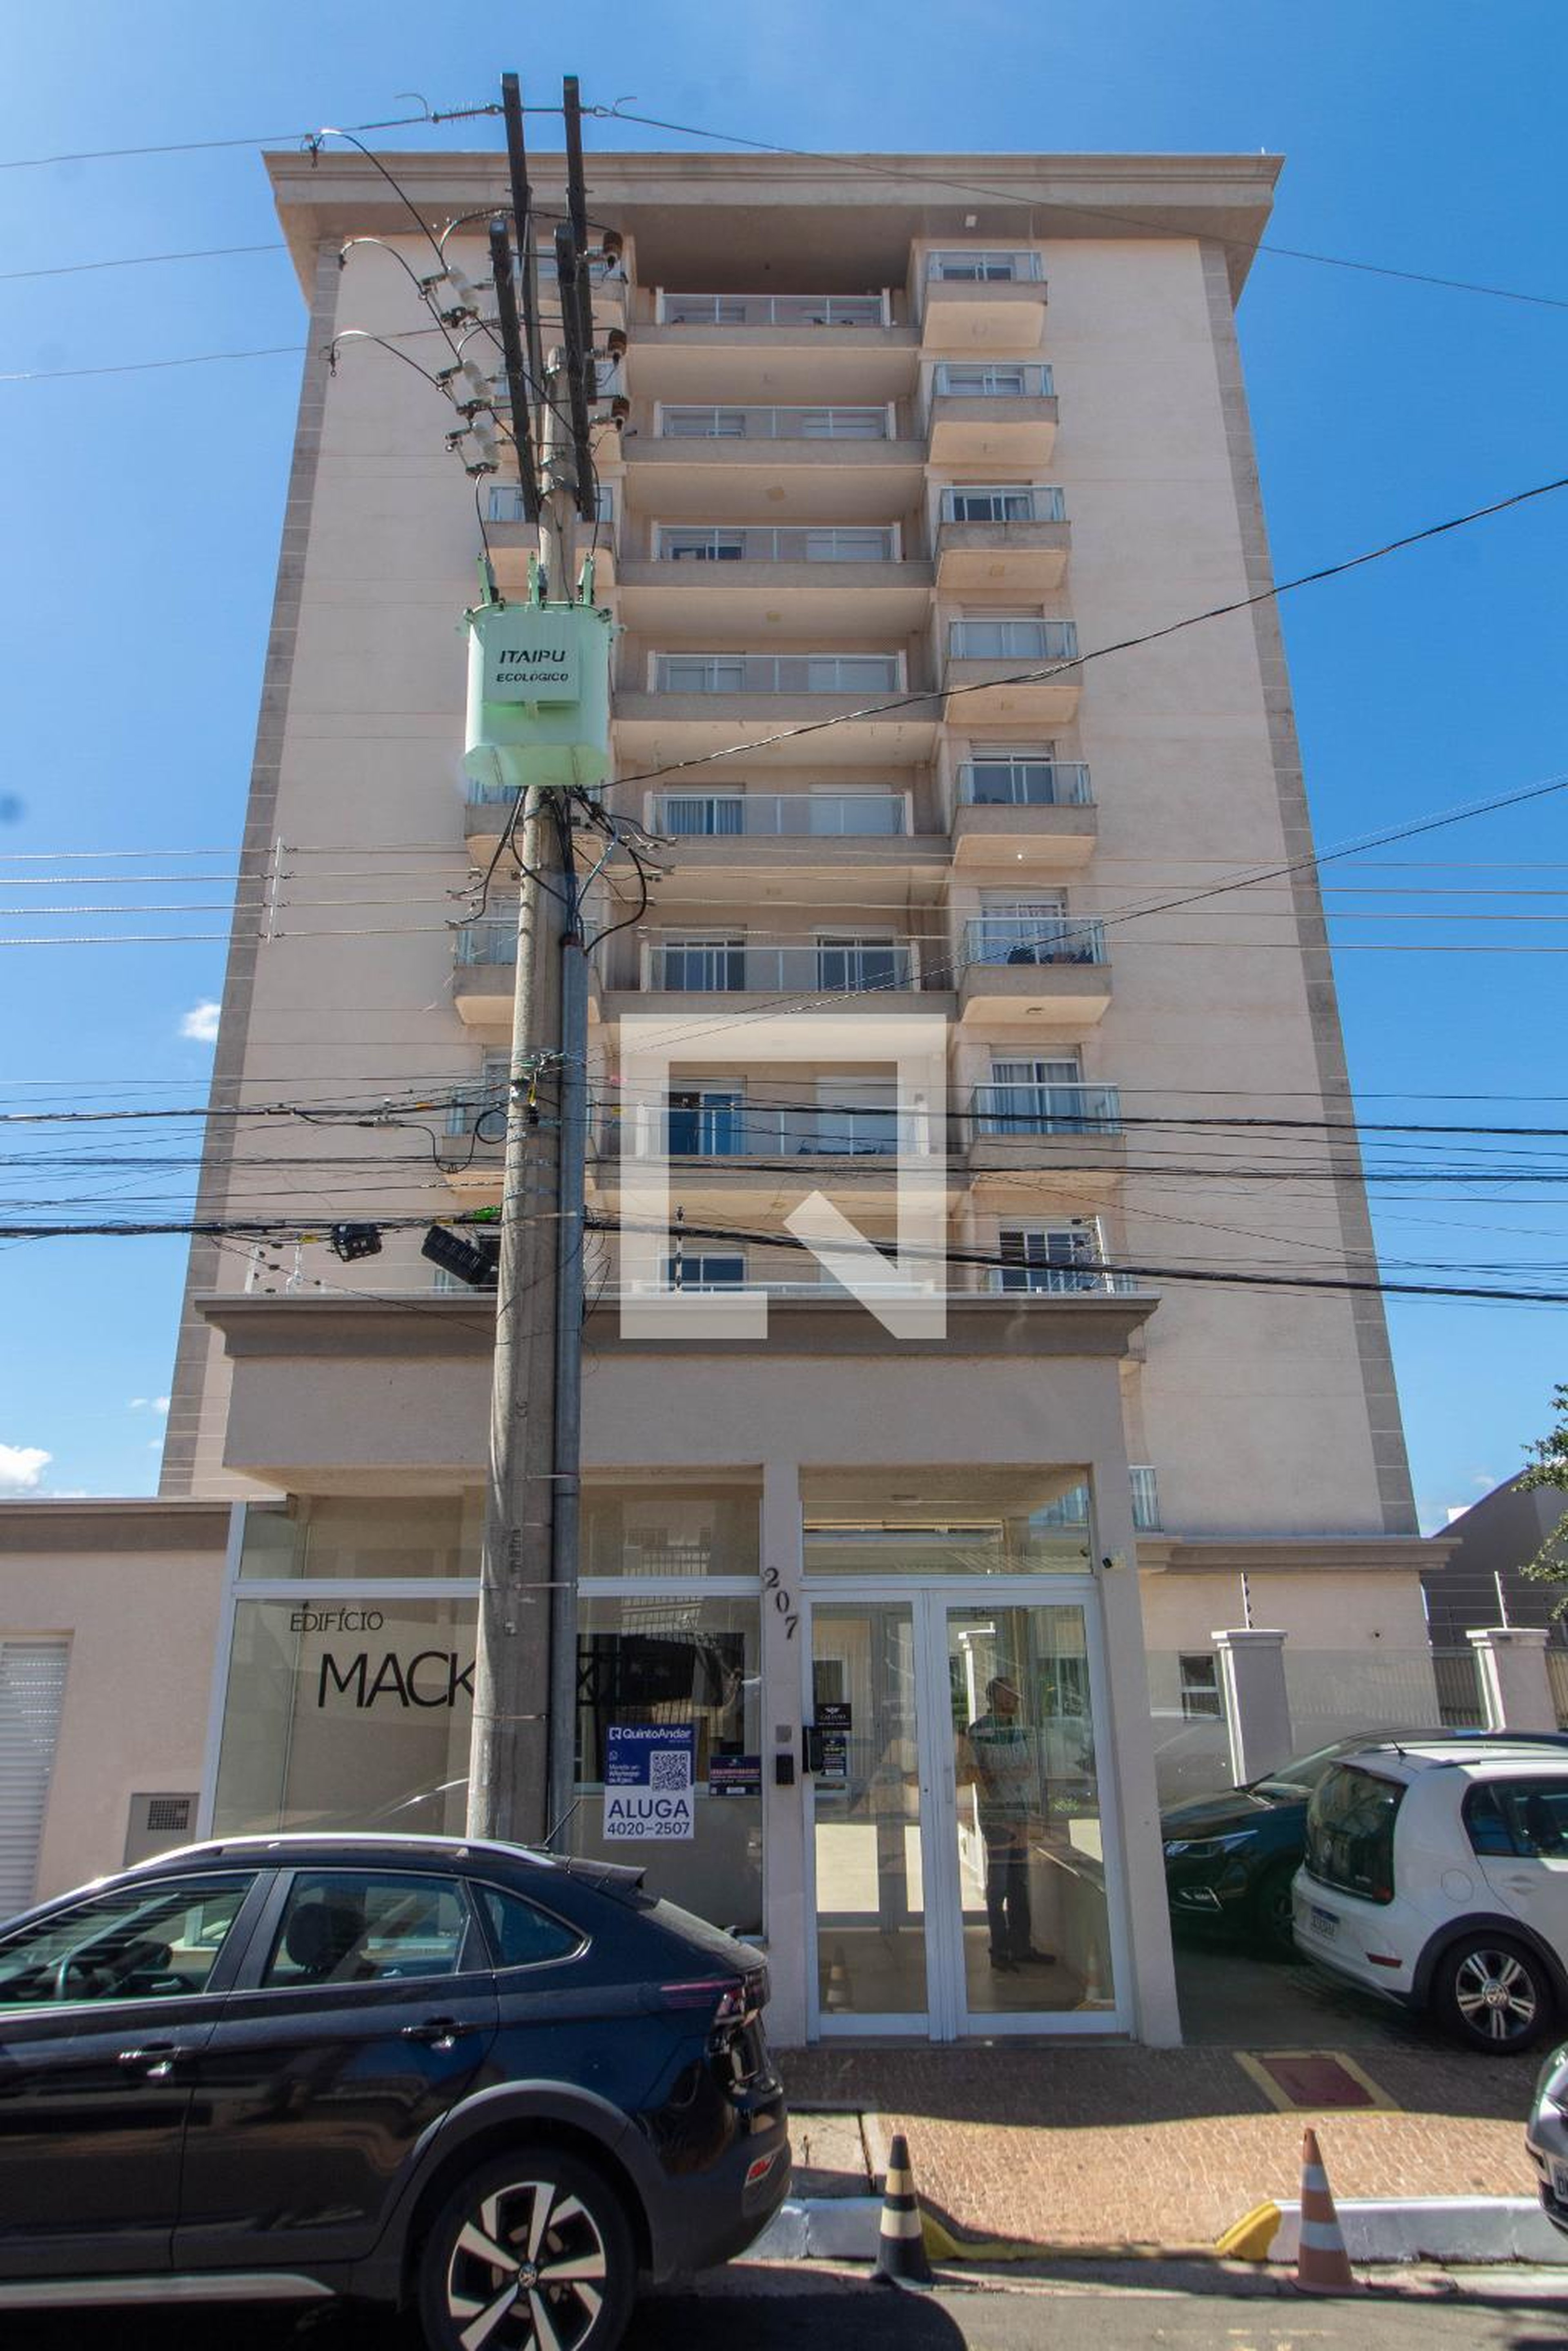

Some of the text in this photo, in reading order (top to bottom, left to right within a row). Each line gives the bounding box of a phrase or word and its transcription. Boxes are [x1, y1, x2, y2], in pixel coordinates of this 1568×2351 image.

[499, 650, 566, 664] ITAIPU
[763, 1567, 799, 1640] 207
[290, 1608, 384, 1632] EDIFÍCIO
[623, 1728, 691, 1739] QuintoAndar
[608, 1799, 690, 1818] ALUGA
[607, 1822, 690, 1835] 4020-2507
